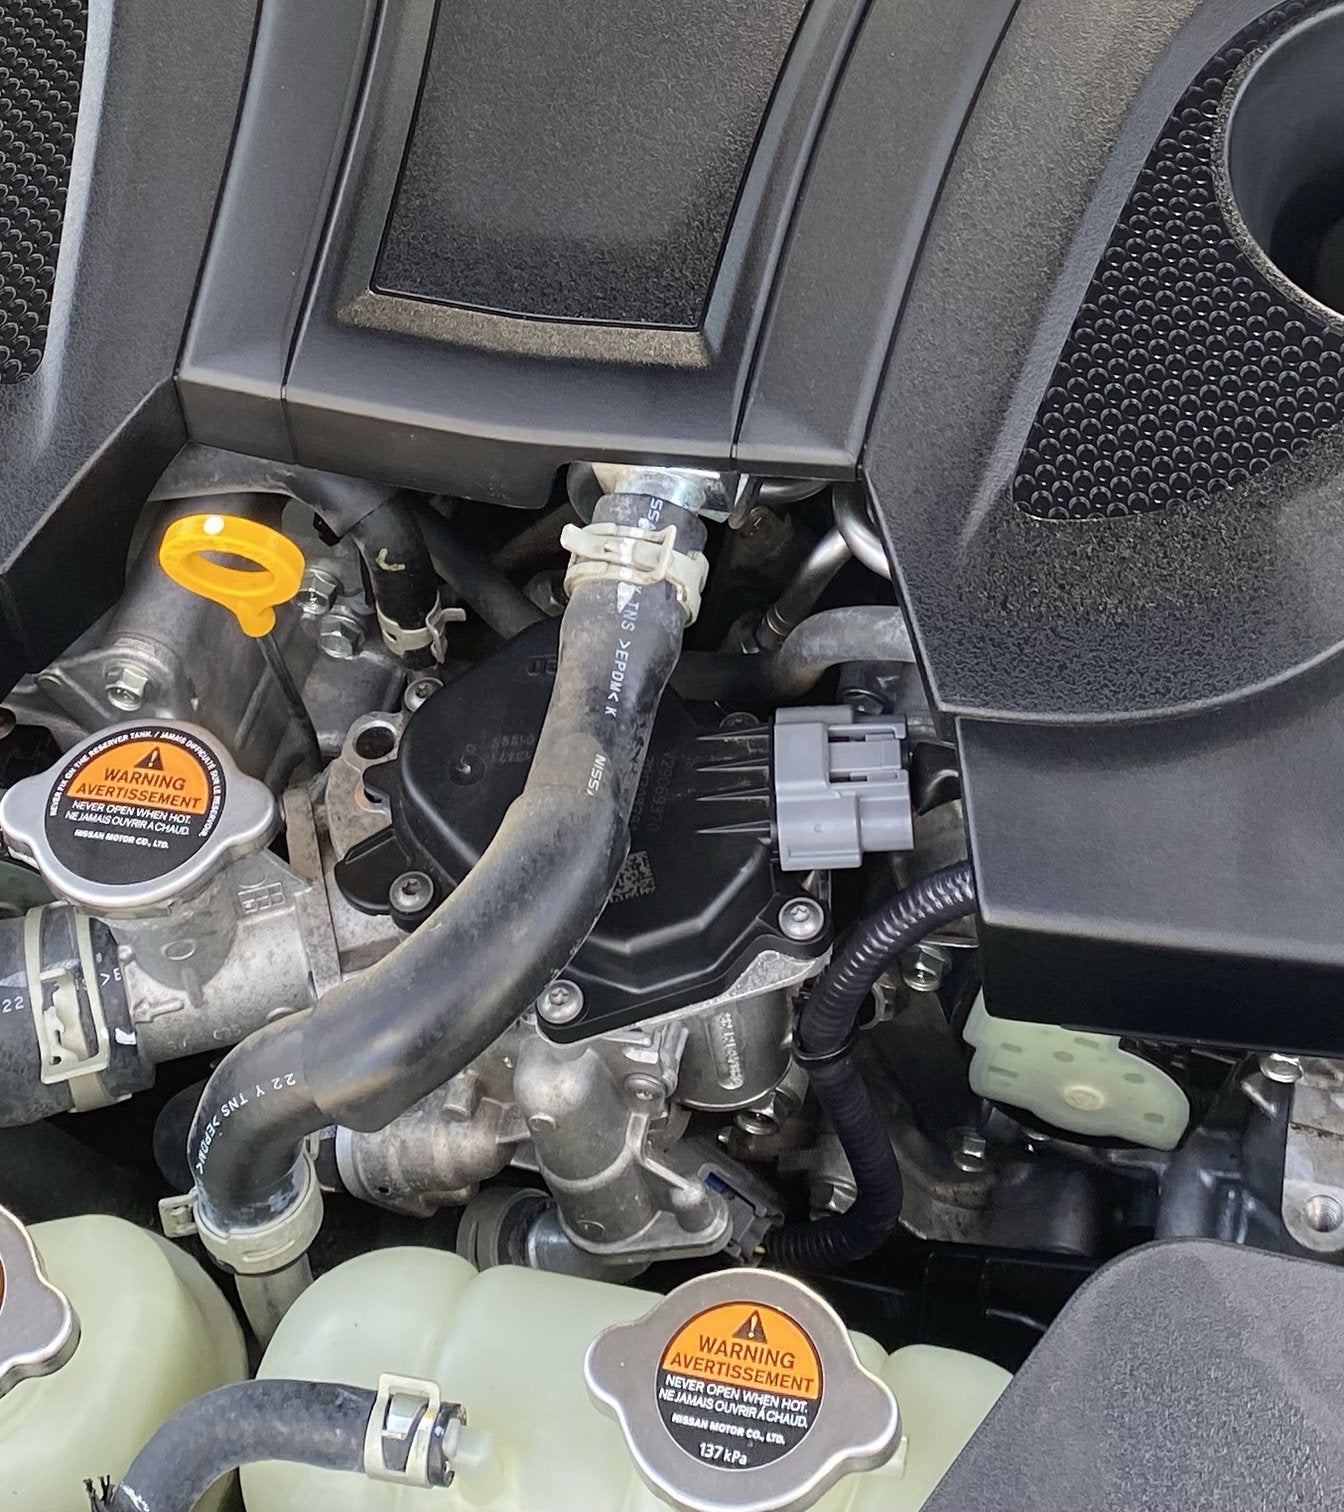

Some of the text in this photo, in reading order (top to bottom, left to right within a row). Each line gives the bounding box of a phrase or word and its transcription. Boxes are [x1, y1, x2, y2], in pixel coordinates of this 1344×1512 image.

[605, 705, 618, 718] K
[104, 768, 186, 791] WARNING
[76, 782, 202, 809] AVERTISSEMENT
[65, 810, 79, 821] NE
[78, 813, 111, 825] JAMAIS
[111, 817, 147, 829] OUVRIR
[154, 822, 190, 836] CHAUD.
[72, 800, 191, 825] NEVER OPEN WHEN HOT.
[74, 829, 105, 840] NISSAN
[105, 833, 135, 843] MOTOR
[2, 995, 25, 1013] 22
[256, 1085, 265, 1098] Y
[271, 1072, 296, 1090] 22
[221, 1092, 249, 1117] TNS
[699, 1334, 796, 1370] WARNING
[670, 1352, 814, 1393] AVERTISSEMENT
[665, 1373, 808, 1413] NEVER OPEN WHEN HOT.
[658, 1387, 676, 1401] NE
[674, 1391, 714, 1410] JAMAIS
[714, 1400, 757, 1419] OUVRIR
[765, 1410, 808, 1429] CHAUD.
[671, 1412, 708, 1429] NISSAN
[709, 1421, 745, 1437] MOTOR
[766, 1432, 786, 1445] LTD.
[699, 1442, 748, 1466] 137 kPa
